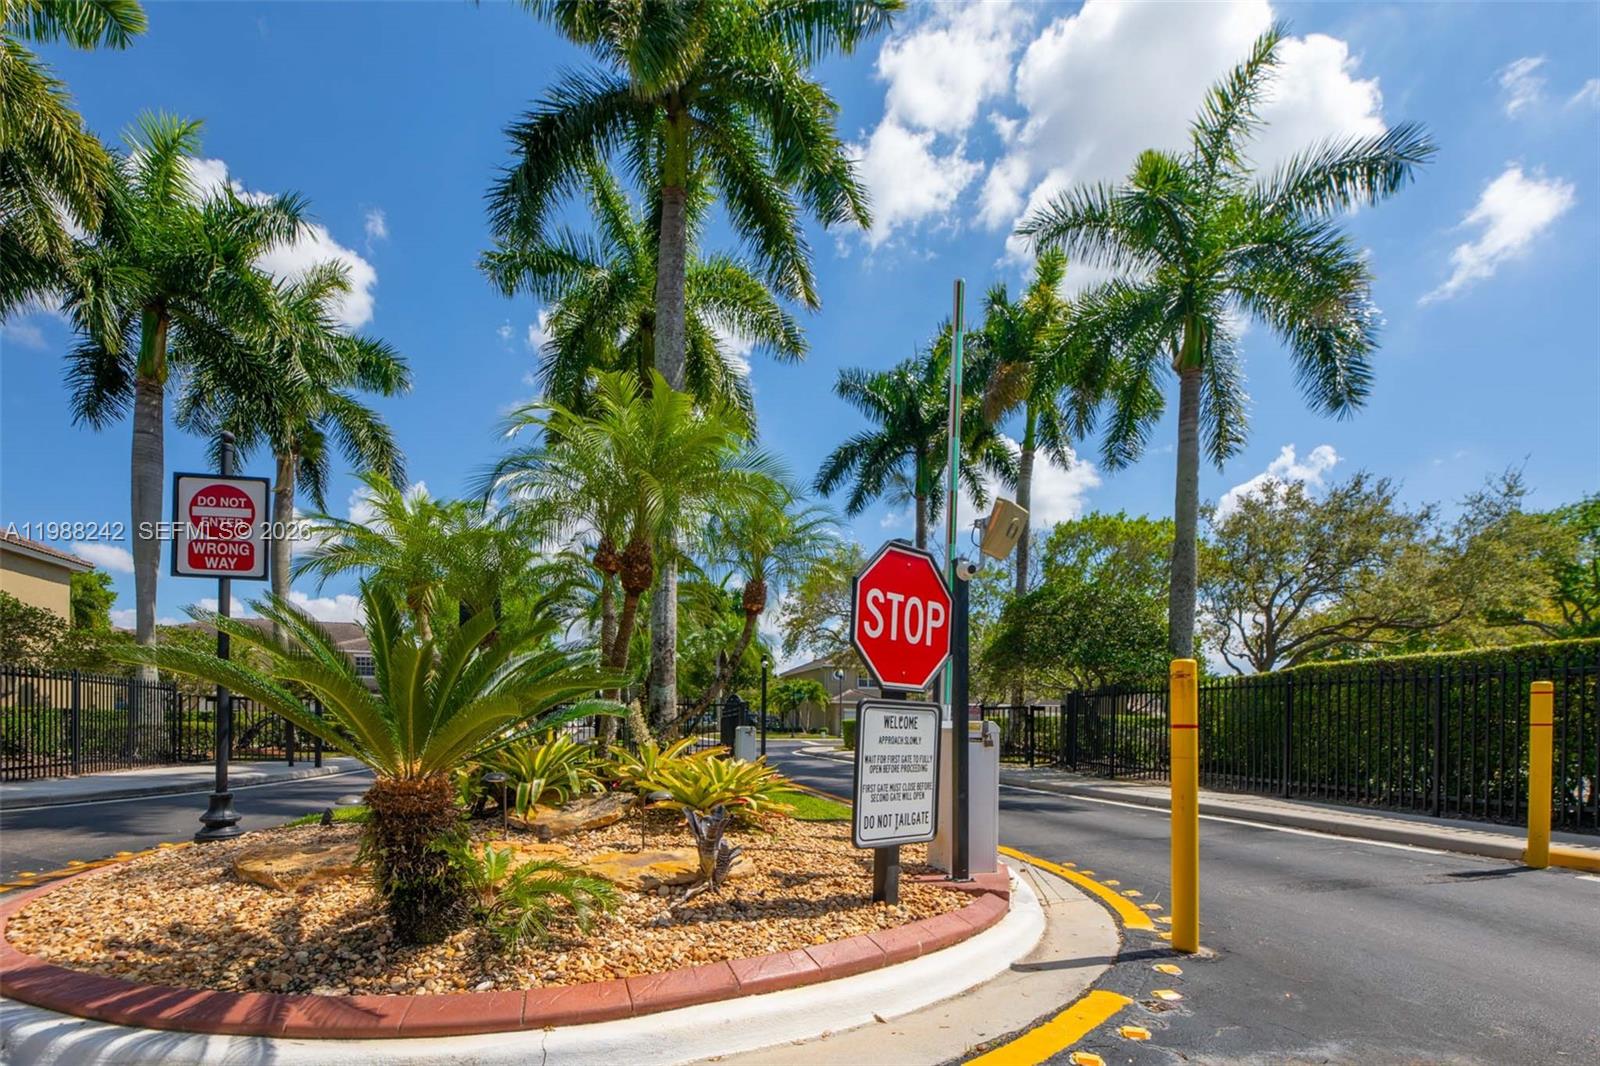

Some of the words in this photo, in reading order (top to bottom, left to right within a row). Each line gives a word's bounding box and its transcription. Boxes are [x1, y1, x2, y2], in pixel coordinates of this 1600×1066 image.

[197, 496, 216, 507] DO
[220, 497, 247, 508] NOT
[192, 542, 250, 556] WRONG
[205, 556, 237, 569] WAY
[863, 587, 945, 646] STOP
[884, 715, 918, 729] WELCOME
[879, 736, 903, 745] APPROACH
[864, 755, 876, 763] WAIT
[877, 755, 887, 763] FOR
[869, 765, 882, 774] OPEN
[883, 764, 899, 773] BEFORE
[890, 793, 901, 801] GATE
[913, 792, 925, 800] OPEN
[864, 815, 874, 829] DO
[877, 814, 892, 828] NOT
[895, 811, 929, 827] TAILGATE
